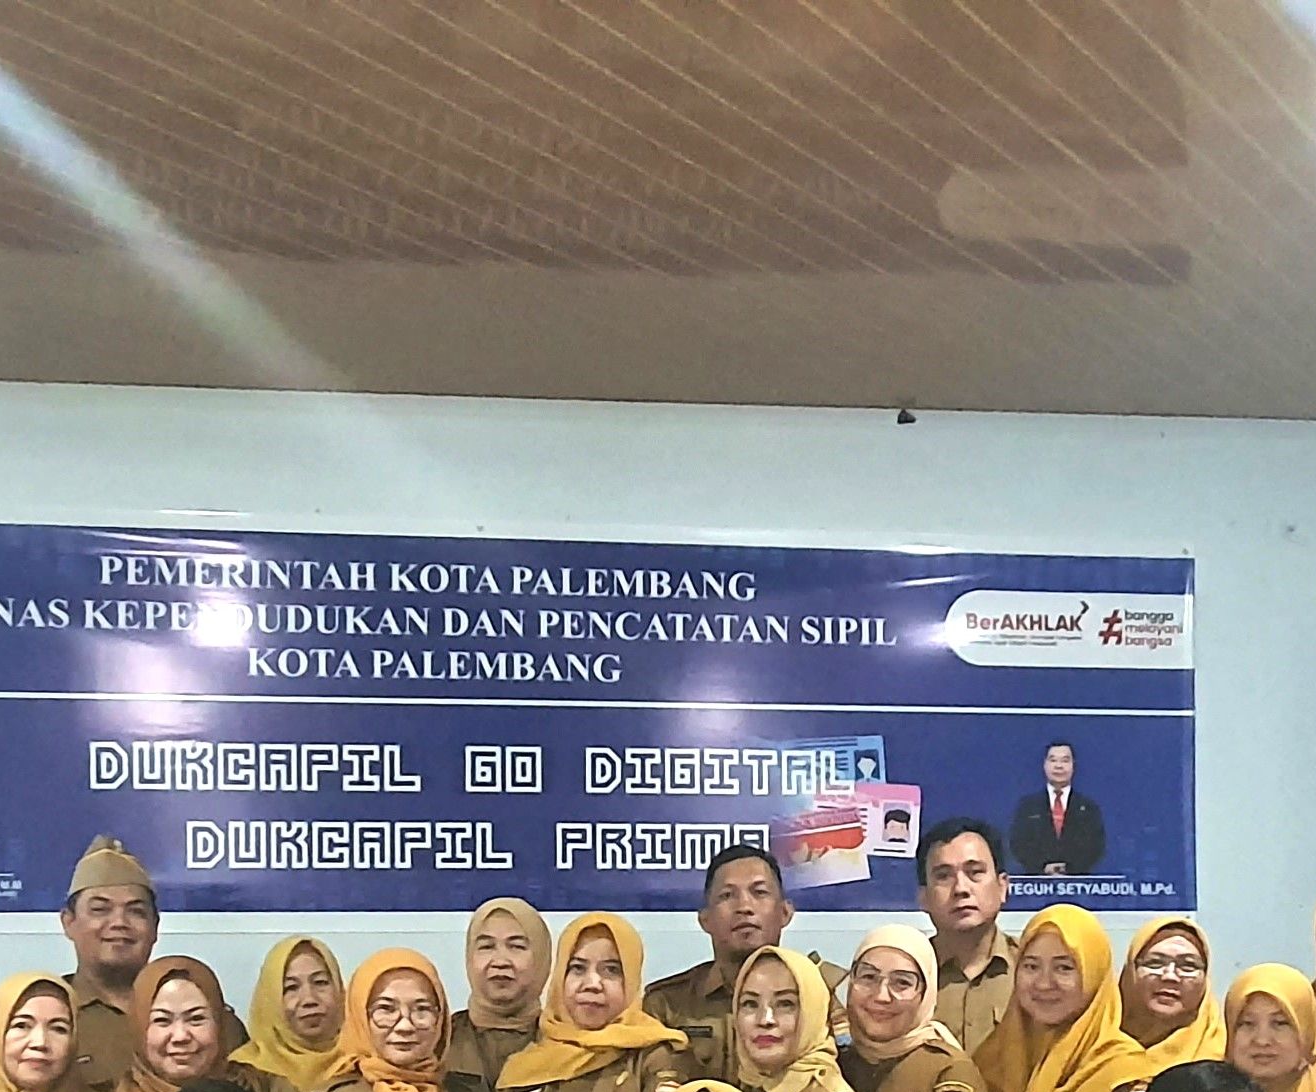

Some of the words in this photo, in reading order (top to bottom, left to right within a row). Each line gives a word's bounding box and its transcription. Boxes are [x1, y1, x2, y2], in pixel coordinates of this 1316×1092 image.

[99, 556, 376, 591] PEMERINTAH
[388, 562, 501, 594] KOTA
[511, 566, 756, 600] PALEMBANG
[84, 600, 429, 637] KEPEDUDUKAN
[442, 606, 525, 637] DAN
[538, 609, 789, 643] PENCATATAN
[801, 615, 898, 646] SIPIL
[965, 612, 1083, 632] BerAKHLAK
[1124, 609, 1174, 623] bangga
[1124, 636, 1173, 650] bangsa
[248, 647, 361, 679] KOTA
[371, 650, 623, 683] PALEMBANG
[89, 740, 422, 793] DUKCAPIL
[464, 744, 543, 794] GO
[585, 746, 856, 796] DIGITAL
[186, 820, 514, 870] DUKCAPIL
[1007, 882, 1054, 896] TEGUH
[1057, 883, 1137, 897] SETYABUDI,
